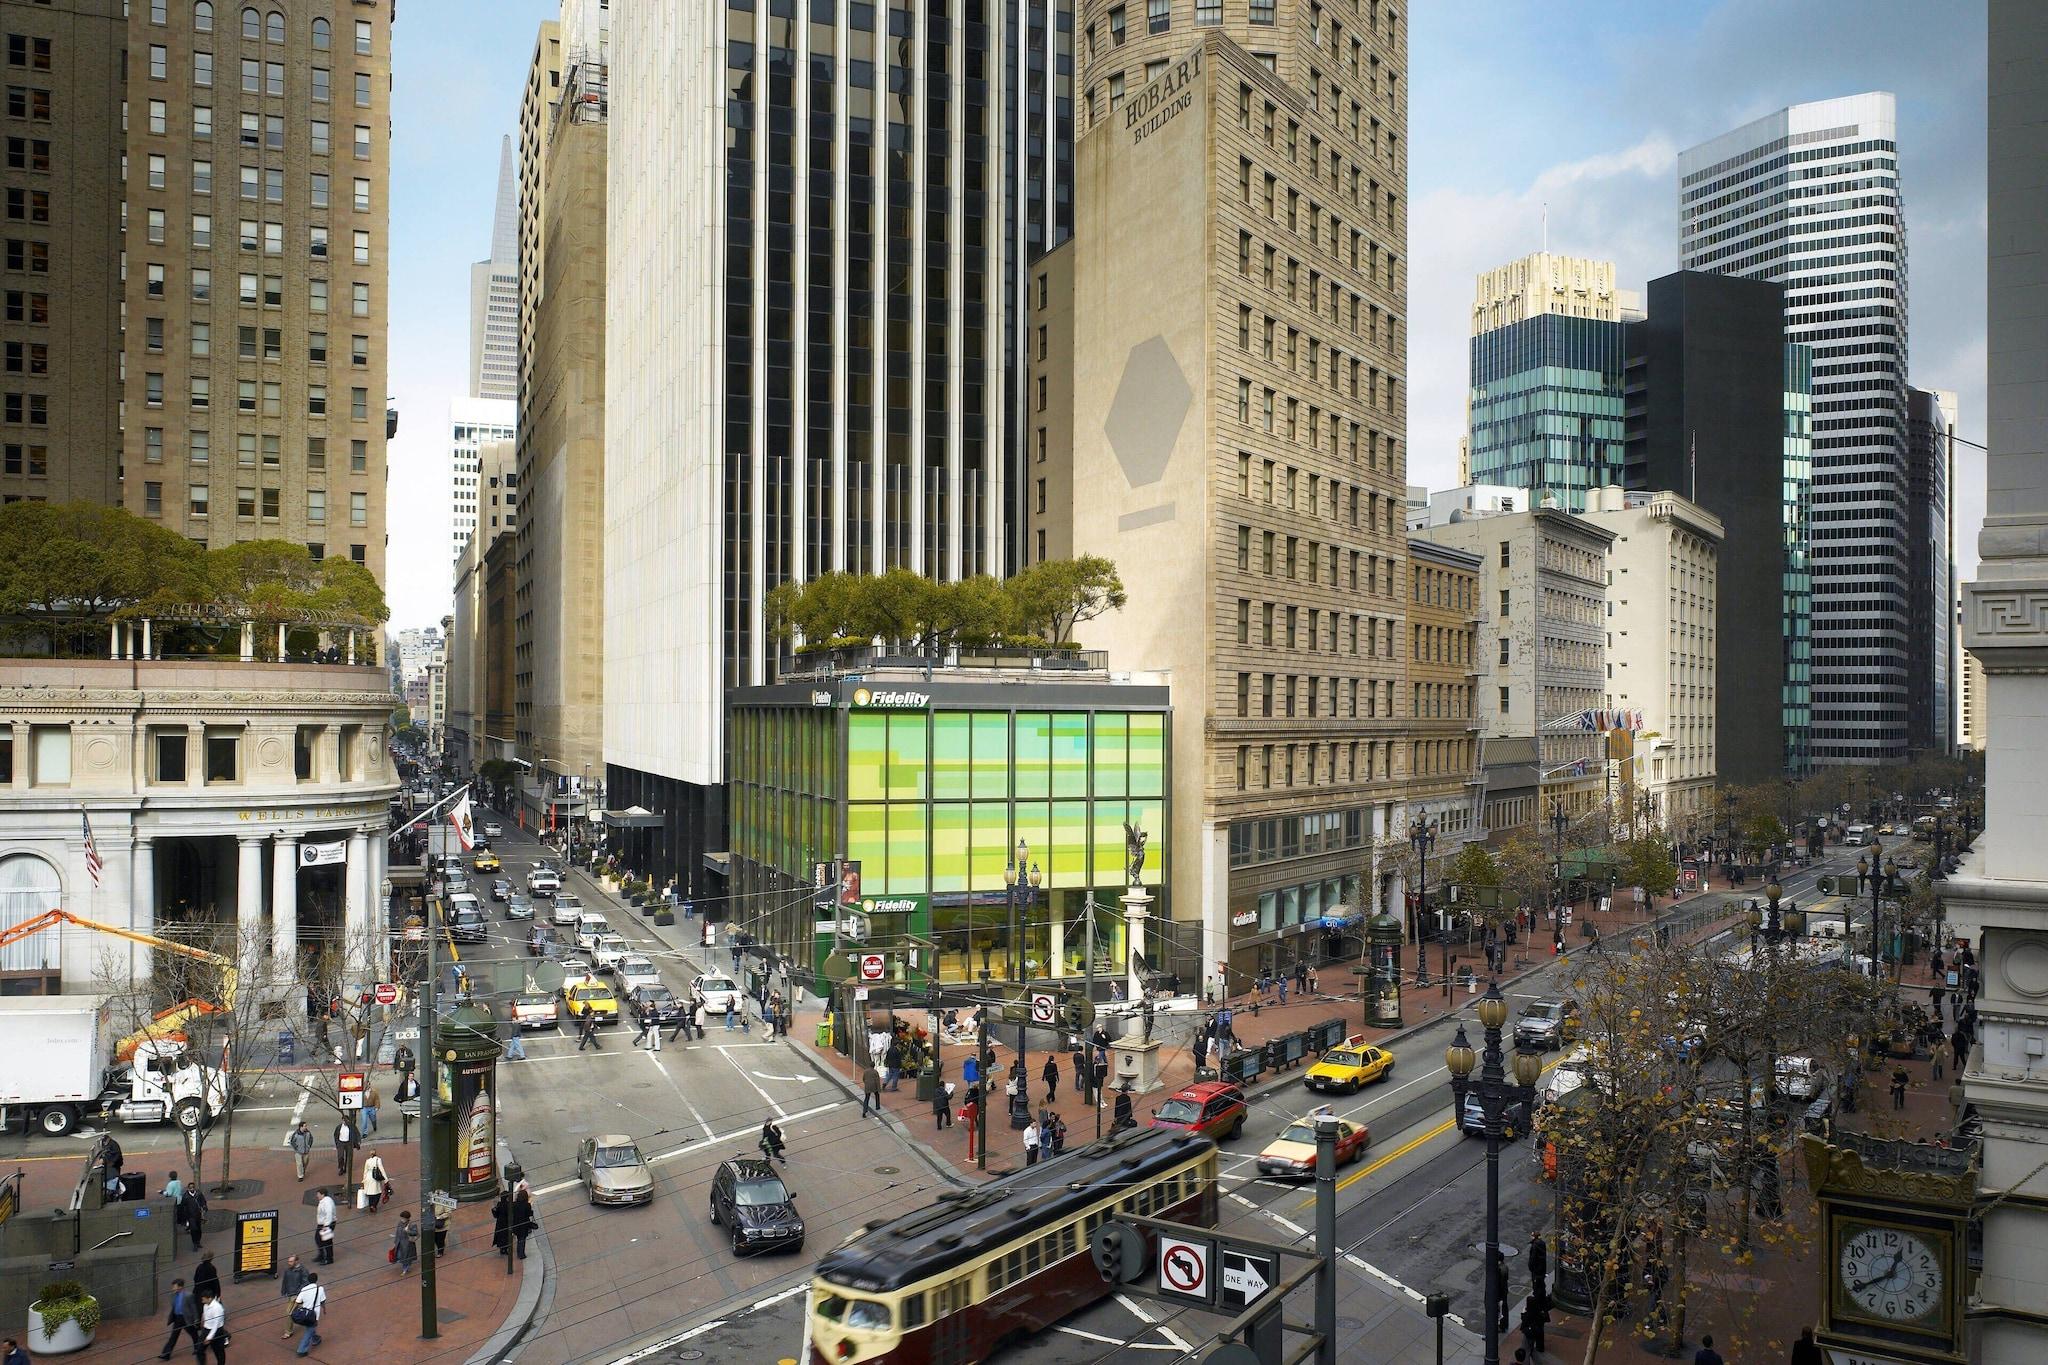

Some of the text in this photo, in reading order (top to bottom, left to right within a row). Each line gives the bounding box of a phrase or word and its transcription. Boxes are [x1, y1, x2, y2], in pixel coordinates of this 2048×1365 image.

[1126, 48, 1202, 130] HOBART
[1134, 90, 1192, 145] BUILDING
[871, 691, 930, 707] Fidelity
[239, 809, 304, 821] WELLS
[315, 807, 360, 818] FARGO
[875, 900, 918, 912] Fidelity
[1866, 1234, 1878, 1249] 11
[1884, 1233, 1898, 1247] 12
[1908, 1240, 1914, 1254] 1
[1849, 1244, 1865, 1259] 10
[1847, 1261, 1857, 1276] 9
[1920, 1255, 1930, 1269] 2
[1225, 1274, 1264, 1288] ONE WAY
[1925, 1273, 1936, 1288] 3
[1867, 1293, 1877, 1307] 7
[1918, 1289, 1929, 1303] 4
[1885, 1301, 1896, 1315] 6
[1904, 1300, 1915, 1314] 5
